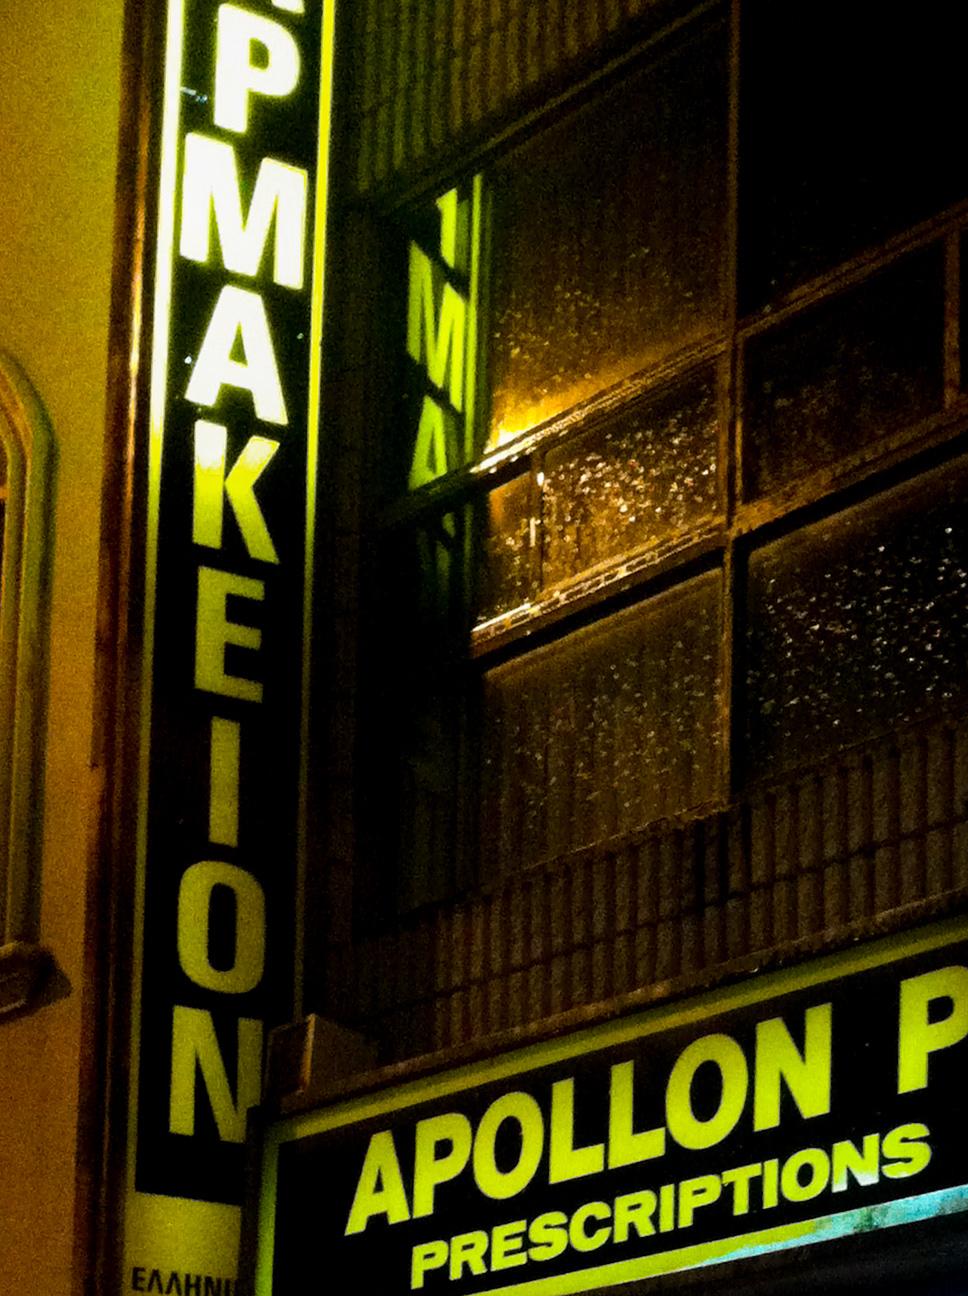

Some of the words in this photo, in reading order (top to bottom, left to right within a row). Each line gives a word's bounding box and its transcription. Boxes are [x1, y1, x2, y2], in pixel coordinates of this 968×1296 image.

[169, 0, 307, 1143] ΡΜΑΚΕΙΟΝ
[344, 1002, 833, 1236] APOLLON
[410, 1123, 932, 1290] PRESCRIPTIONS
